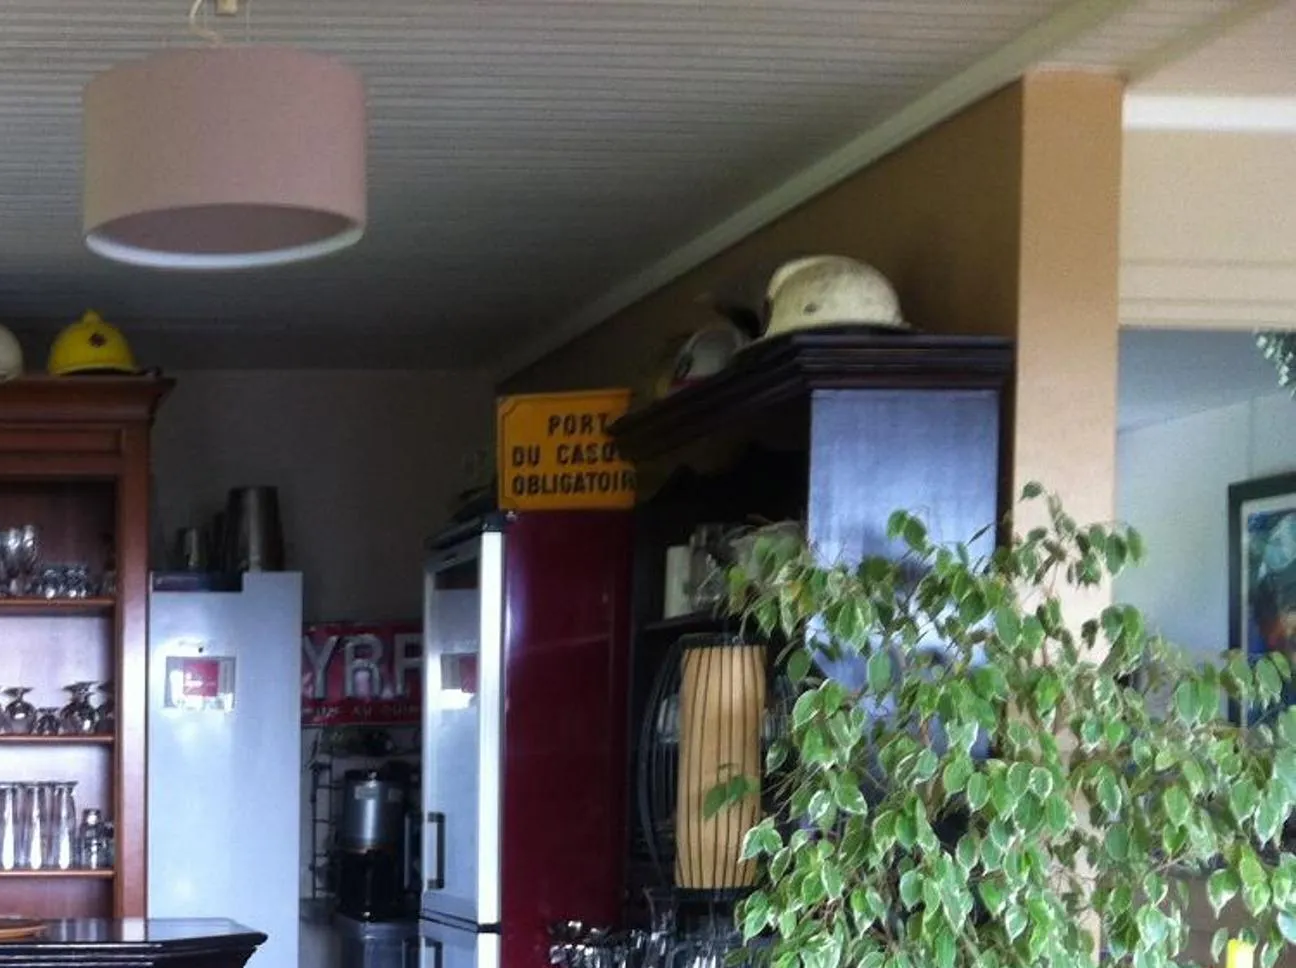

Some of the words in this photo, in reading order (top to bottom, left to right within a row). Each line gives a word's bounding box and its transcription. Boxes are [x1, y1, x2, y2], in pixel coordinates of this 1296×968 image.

[548, 413, 609, 436] PORT
[512, 444, 541, 467] DU
[512, 471, 636, 496] OBLIGATOIR
